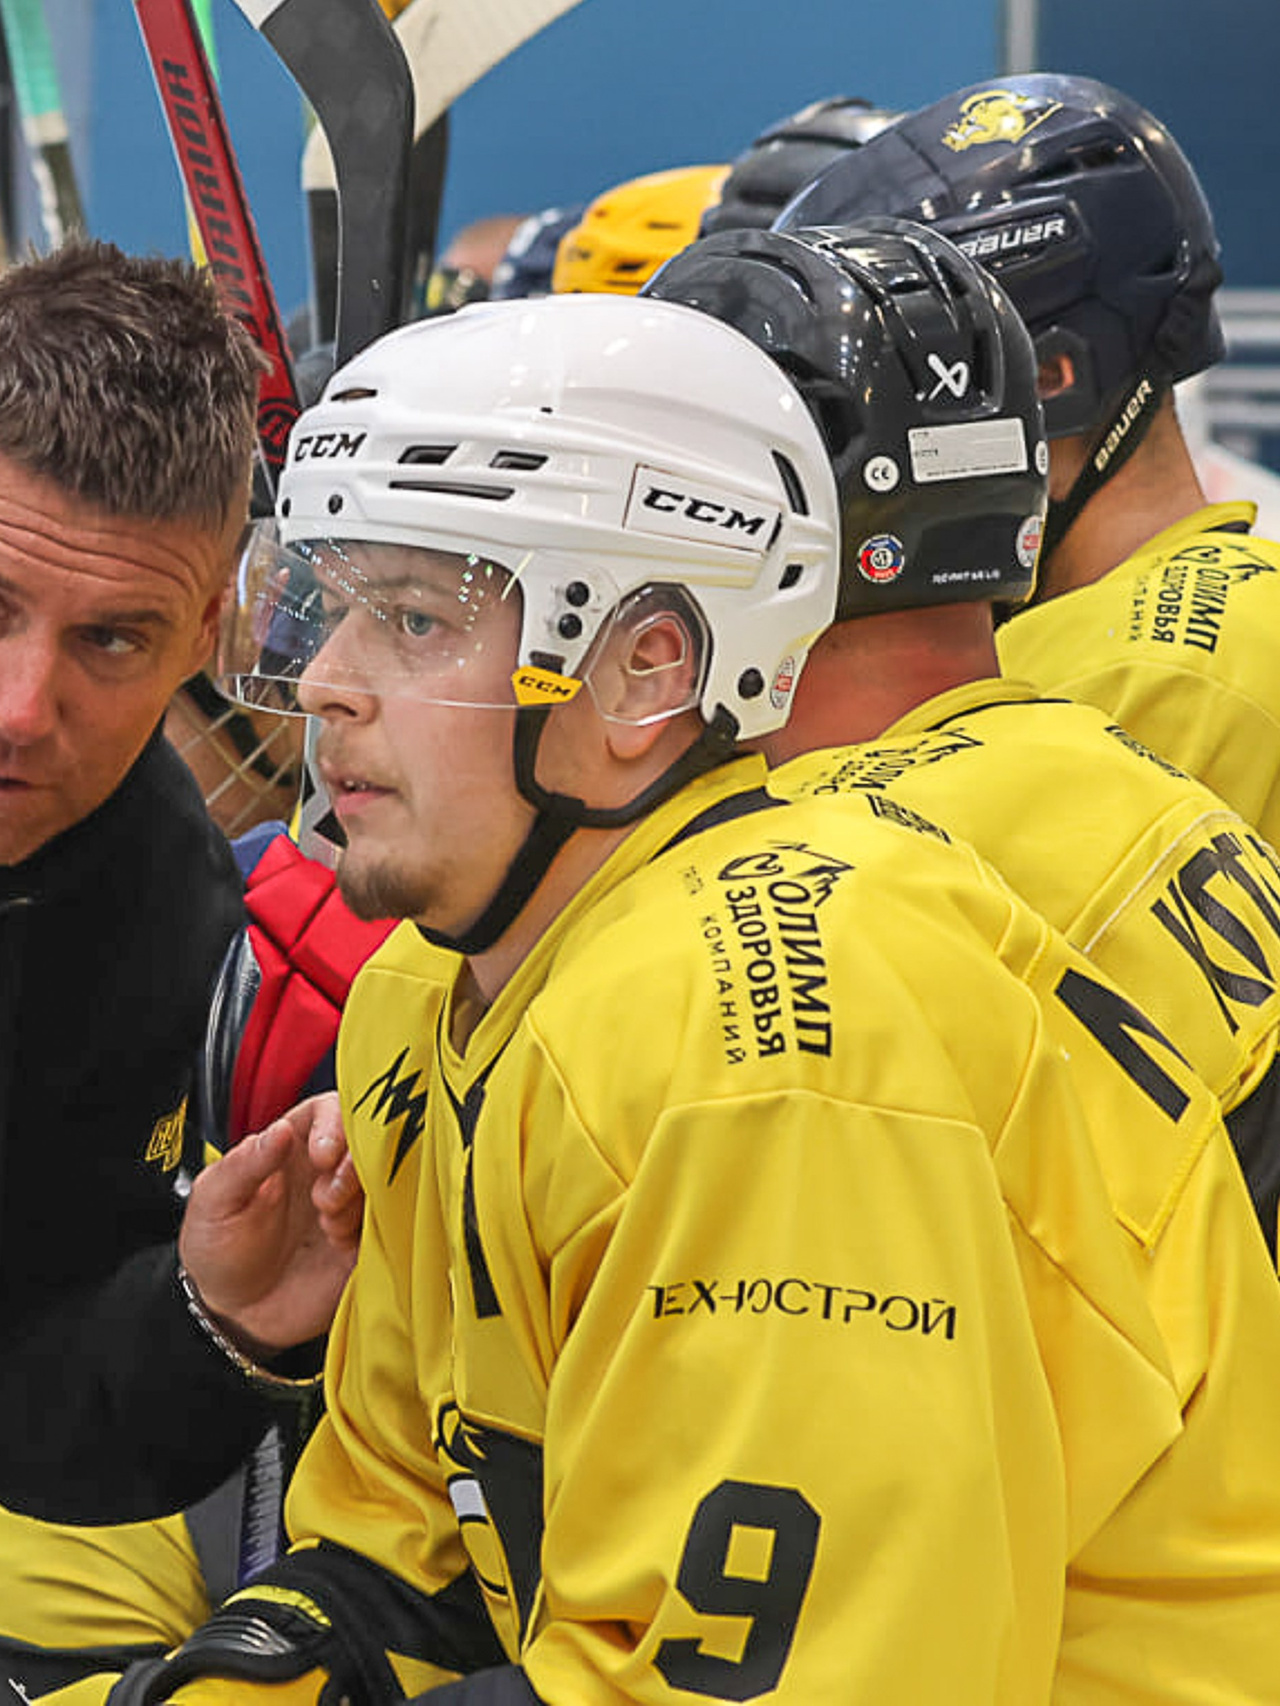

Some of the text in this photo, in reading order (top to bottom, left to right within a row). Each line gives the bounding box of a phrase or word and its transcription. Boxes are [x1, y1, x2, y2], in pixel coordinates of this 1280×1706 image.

[295, 432, 368, 462] CCM
[1095, 380, 1153, 471] BAUER
[643, 486, 766, 535] CCM
[519, 676, 572, 697] CCM
[702, 914, 746, 1065] КОМПАНИЙ
[725, 886, 787, 1058] ЗДОРОВЬЯ
[767, 881, 833, 1058] ОЛИМП
[652, 1479, 822, 1704] 9
